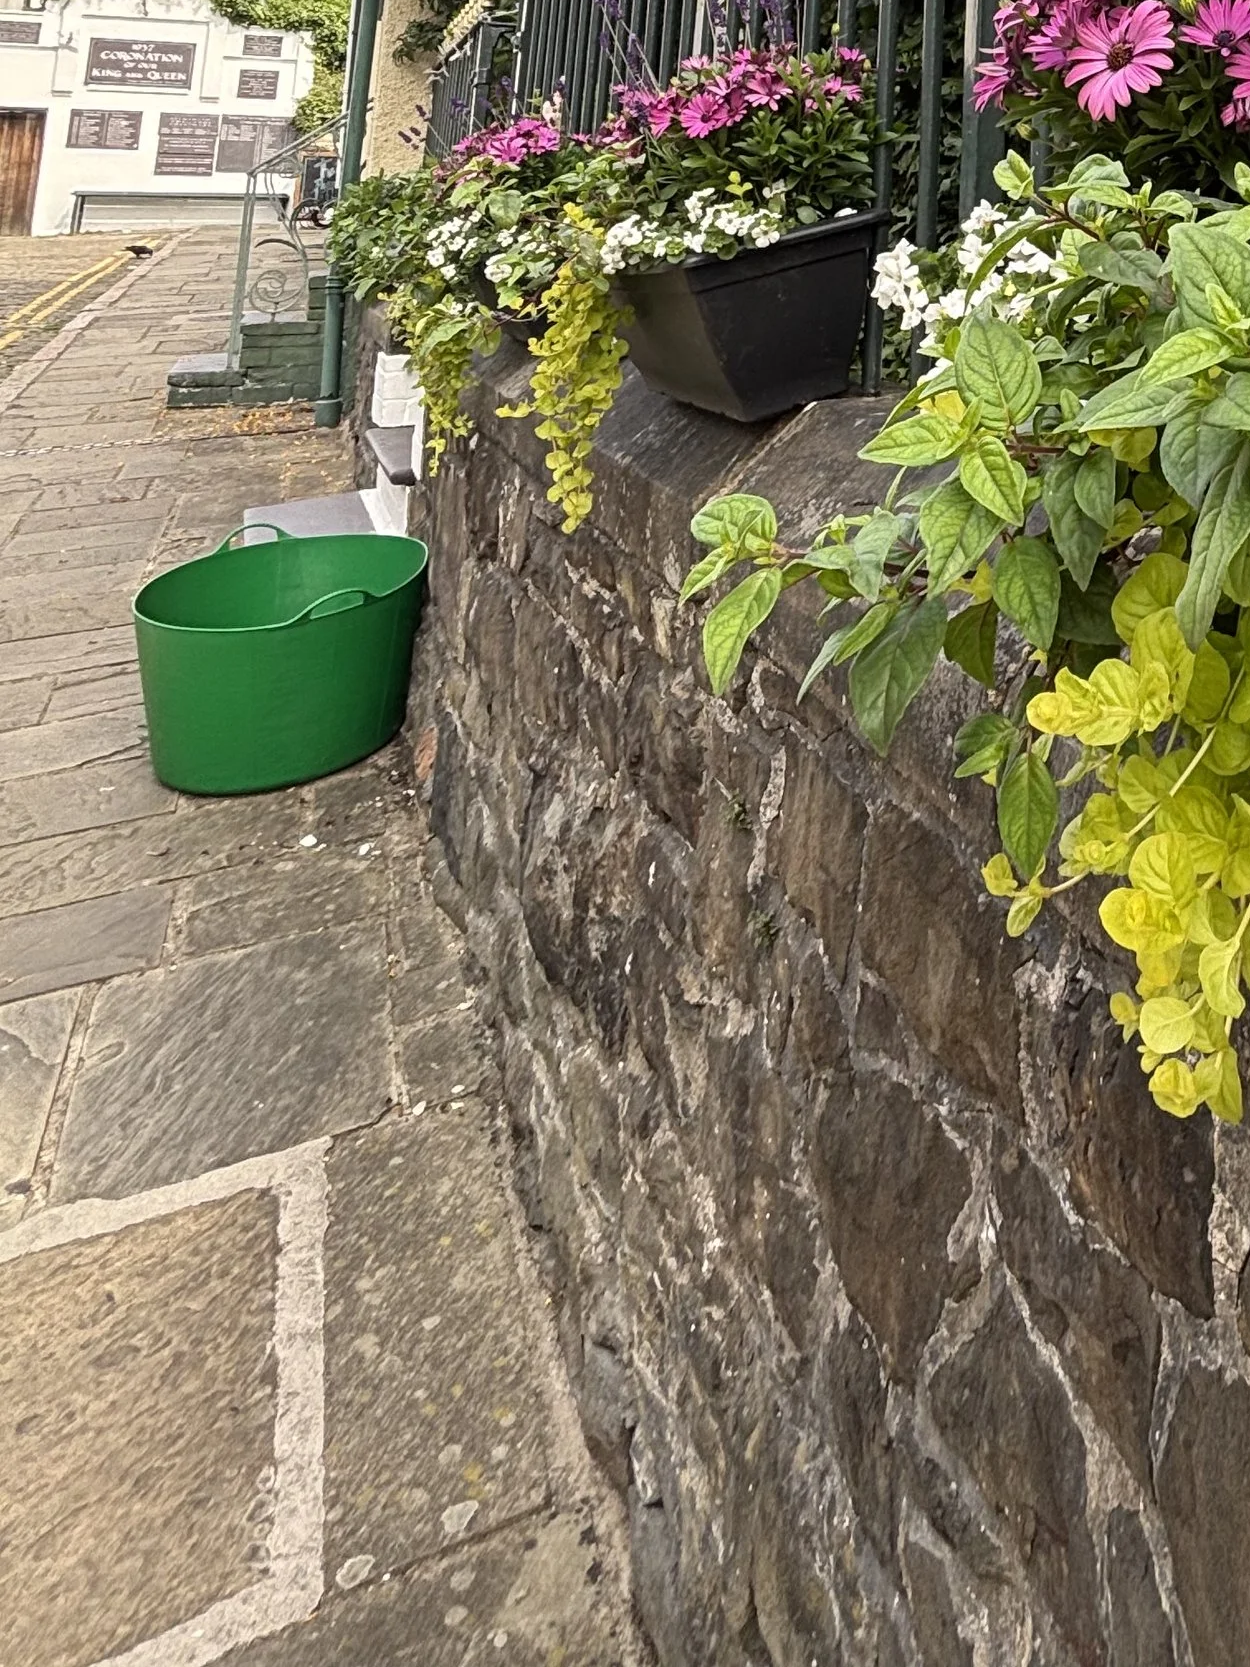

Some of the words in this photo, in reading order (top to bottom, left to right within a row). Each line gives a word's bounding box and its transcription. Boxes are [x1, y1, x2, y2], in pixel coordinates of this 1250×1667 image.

[100, 50, 184, 63] CORONATION
[91, 67, 122, 78] KING
[146, 70, 187, 81] QUEEN
